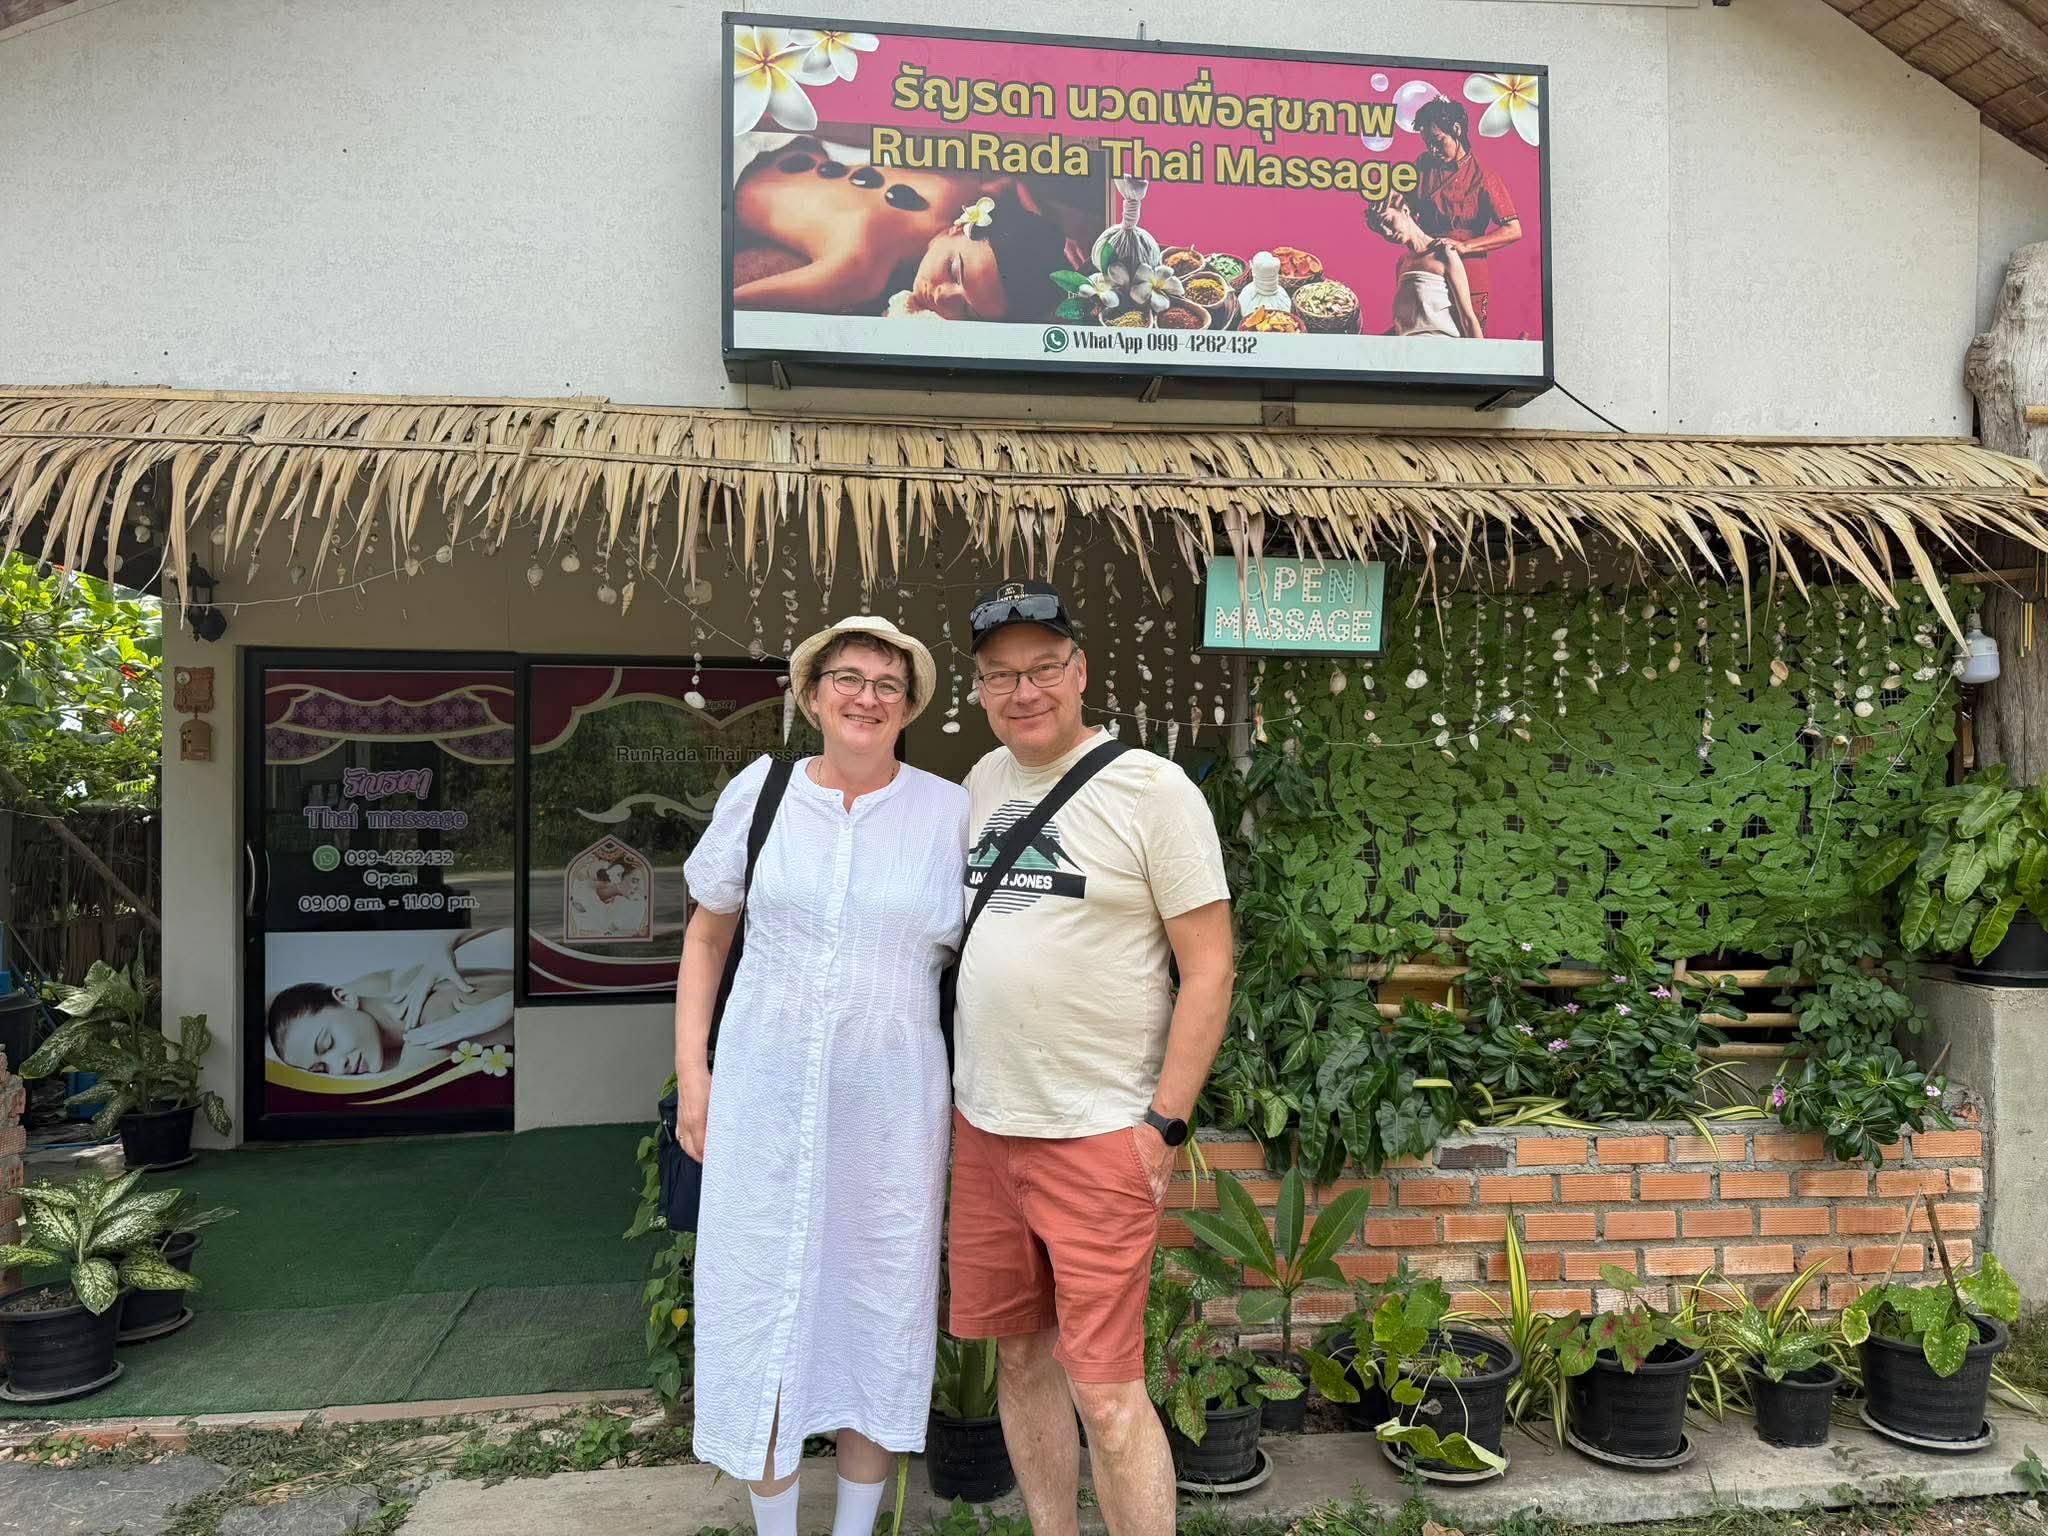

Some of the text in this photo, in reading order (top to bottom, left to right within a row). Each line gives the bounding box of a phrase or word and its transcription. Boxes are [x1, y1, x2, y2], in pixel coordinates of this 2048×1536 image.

[894, 62, 1397, 144] รัญรดา นวดเพื่อสุขภาพ
[871, 125, 1420, 202] RunRada Thai Massage
[1074, 331, 1257, 354] WhatApp 099-4262432
[1214, 606, 1373, 643] MASSAGE
[616, 746, 697, 763] RunRada
[703, 746, 741, 763] Thai
[303, 803, 468, 831] Thai massage
[344, 849, 455, 867] 099-4262432
[363, 869, 413, 889] Open
[1009, 873, 1053, 890] JONES
